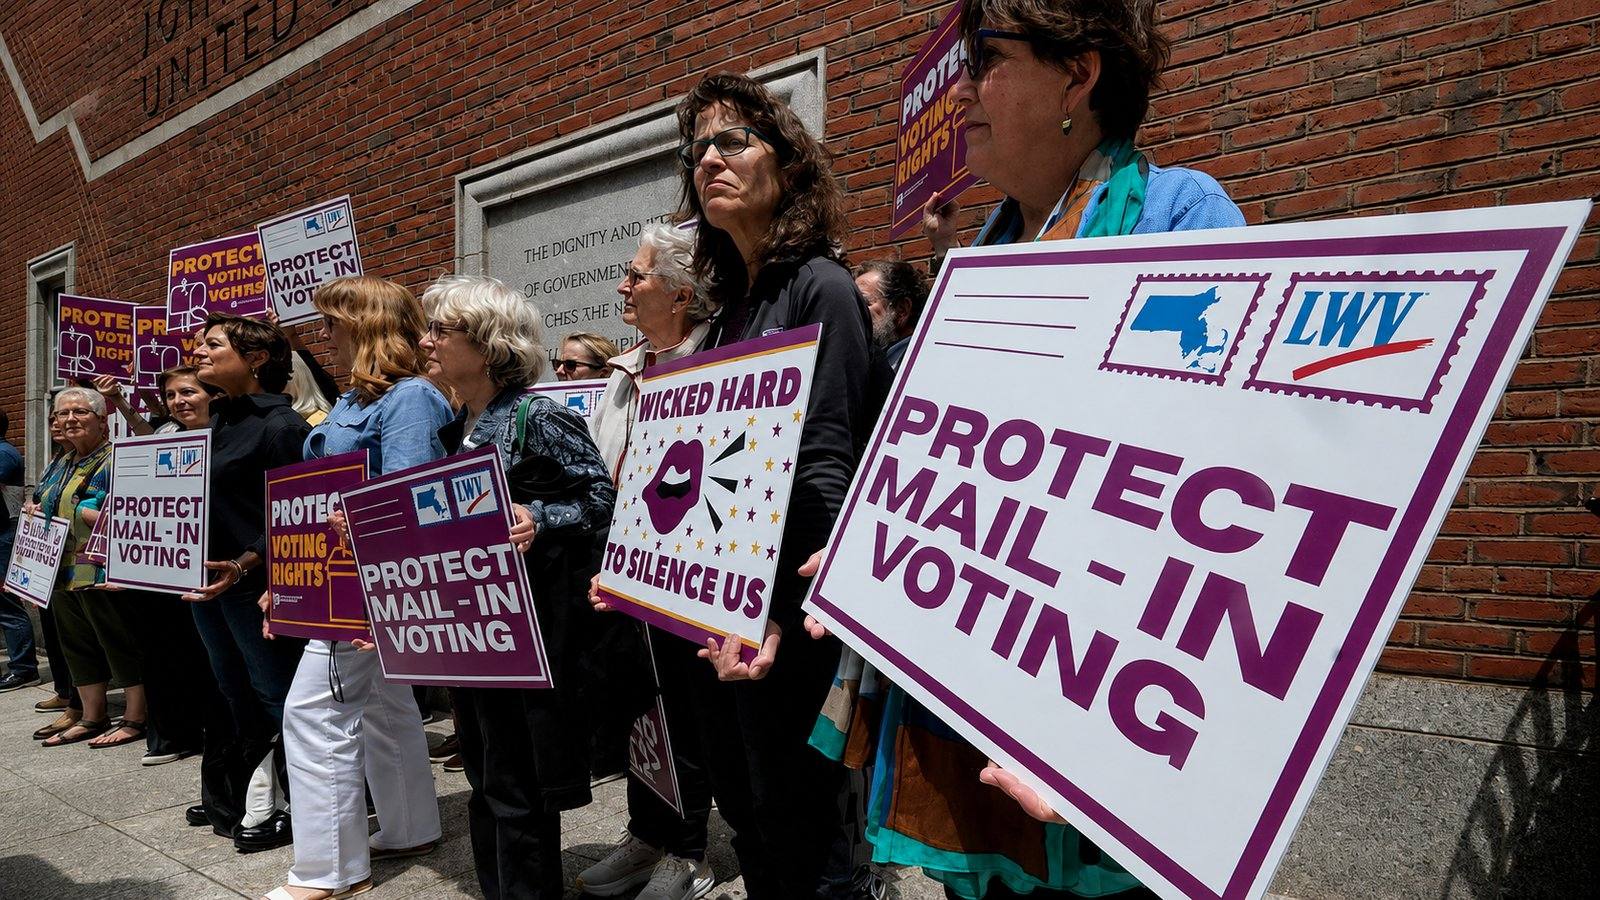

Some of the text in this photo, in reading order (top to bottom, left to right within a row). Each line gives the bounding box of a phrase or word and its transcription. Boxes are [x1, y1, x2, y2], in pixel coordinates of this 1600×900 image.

[133, 0, 298, 117] UNITED
[897, 120, 951, 187] RIGHTS
[269, 240, 353, 278] PROTECT
[523, 221, 642, 264] THE DIGNITY AND
[207, 264, 266, 286] VOTING
[272, 269, 323, 294] MAIL
[333, 258, 357, 278] IN
[523, 260, 634, 299] OF GOVERNMEN
[281, 286, 316, 308] VOT
[581, 302, 610, 322] THE
[61, 305, 132, 330] PROTE
[95, 330, 132, 345] VOTI
[638, 366, 802, 422] WICKED HARD
[456, 475, 483, 502] LWV
[886, 395, 1396, 587] PROTECT
[113, 496, 203, 519] PROTECT
[271, 491, 341, 528] PROTEC
[112, 519, 163, 543] MAIL
[176, 522, 200, 545] IN
[271, 532, 327, 559] VOTING
[118, 543, 191, 570] VOTING
[360, 543, 513, 592] PROTECT
[272, 562, 324, 588] RIGHTS
[604, 541, 768, 619] TO SILENCE US
[866, 455, 1062, 588] MAIL
[1136, 558, 1324, 702] IN
[369, 590, 454, 623] MAIL
[474, 581, 522, 616] IN
[385, 620, 517, 654] VOTING
[869, 522, 1206, 771] VOTING
